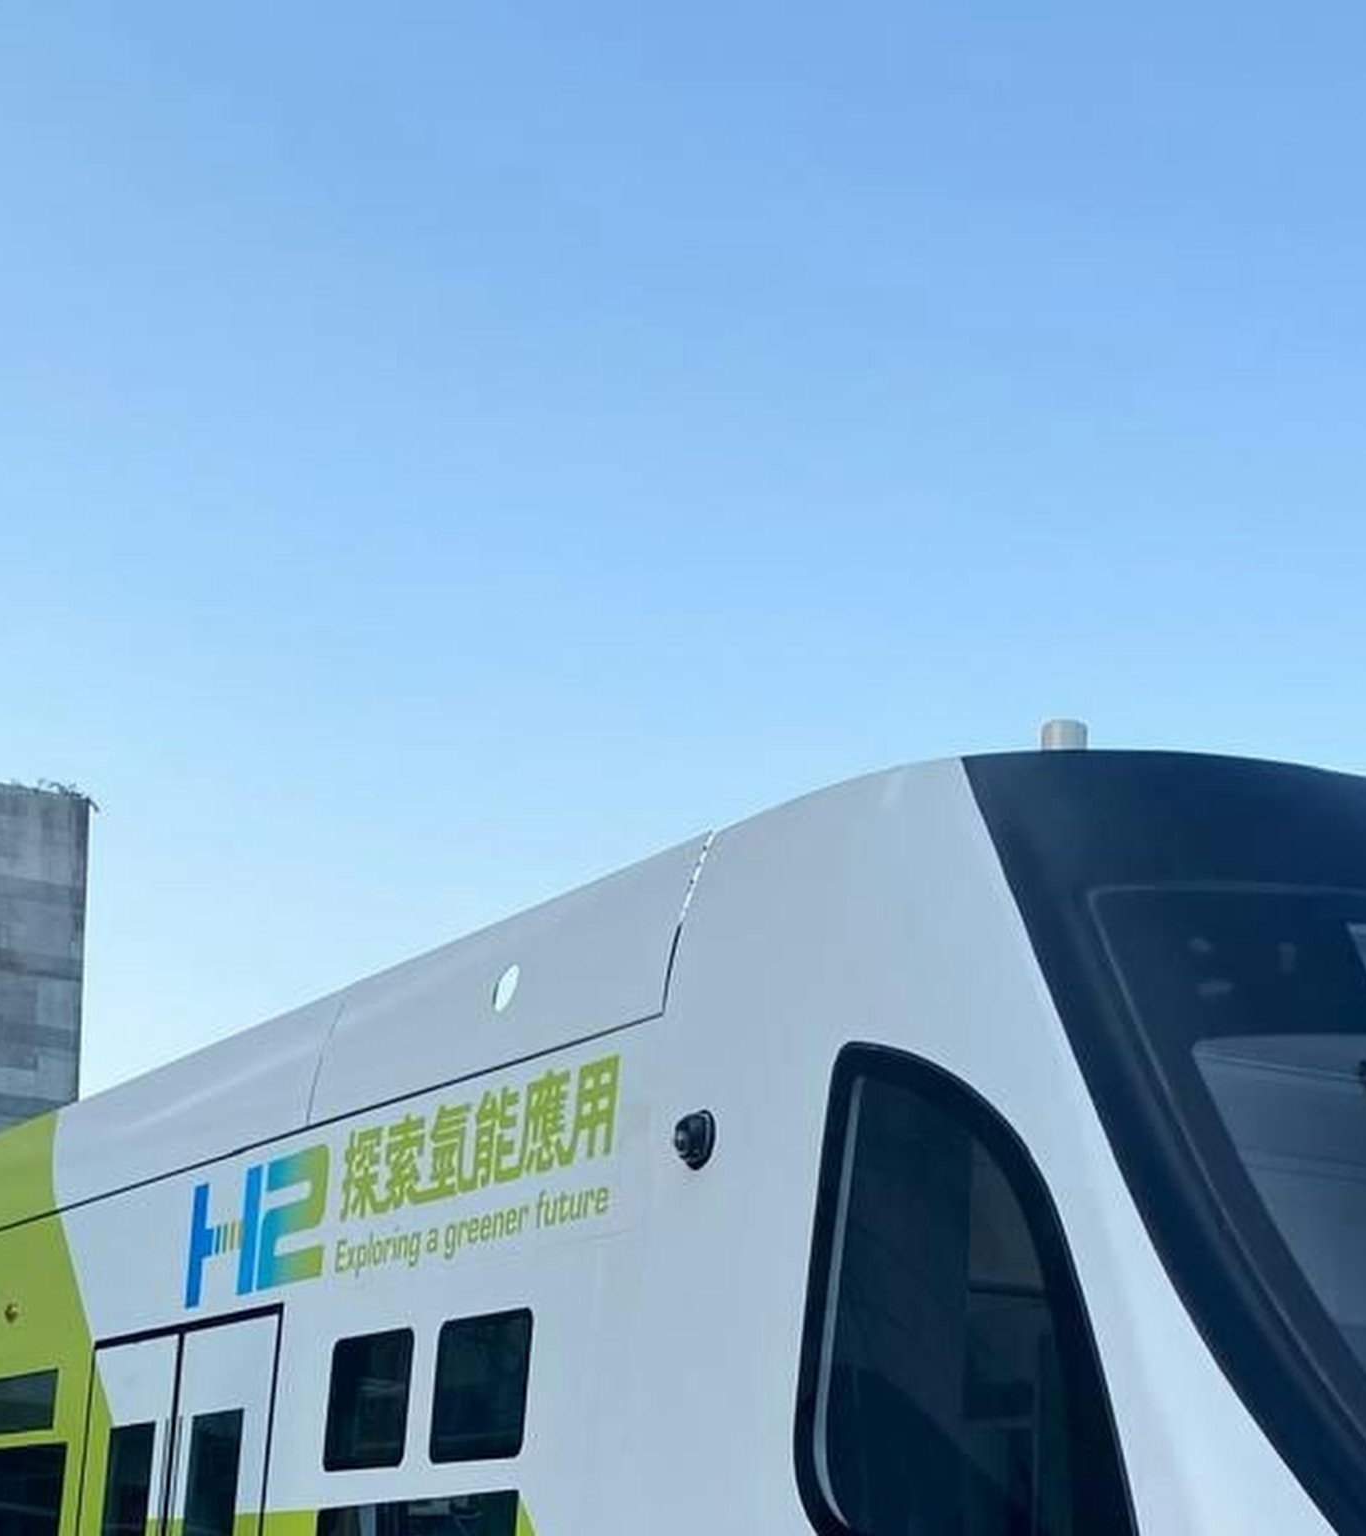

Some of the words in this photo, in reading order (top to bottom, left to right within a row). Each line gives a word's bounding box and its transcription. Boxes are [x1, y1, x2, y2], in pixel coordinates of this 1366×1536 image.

[341, 1054, 620, 1223] 探索氫能應用
[334, 1231, 422, 1277] Exploring
[427, 1228, 439, 1252] a
[444, 1204, 530, 1259] greener
[536, 1187, 610, 1229] future
